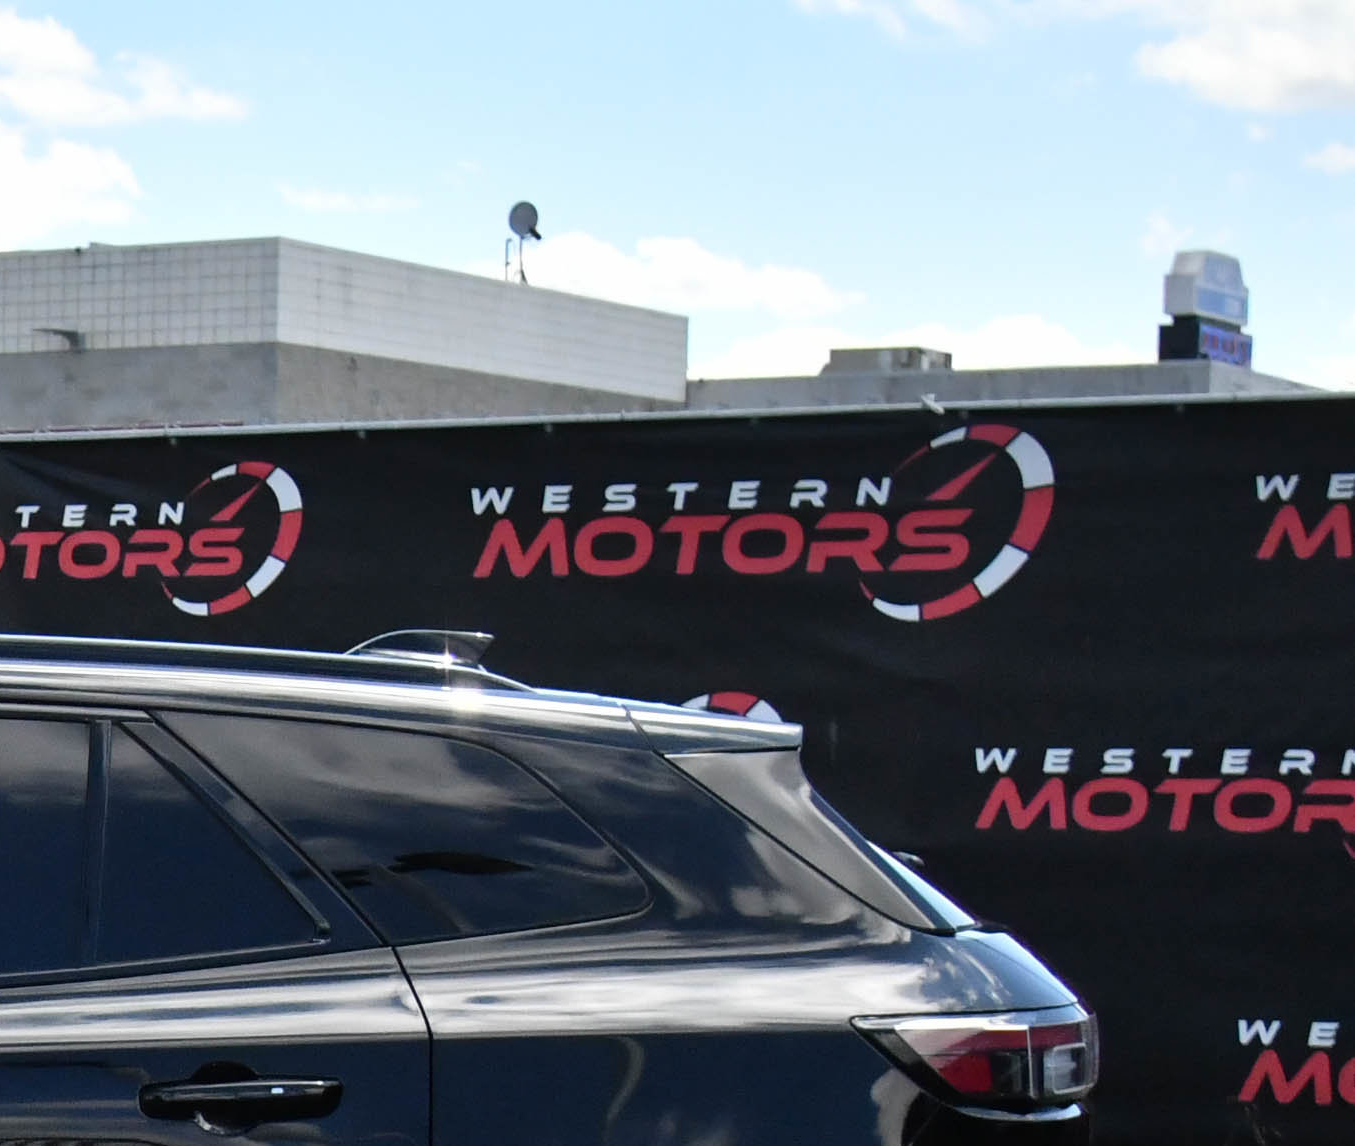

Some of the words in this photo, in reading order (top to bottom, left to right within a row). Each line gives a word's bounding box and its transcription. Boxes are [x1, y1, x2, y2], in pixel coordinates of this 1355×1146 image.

[471, 477, 891, 515] WESTERN
[473, 508, 974, 578] MOTORS
[1238, 1019, 1339, 1047] WE
[1238, 1049, 1355, 1105] M
